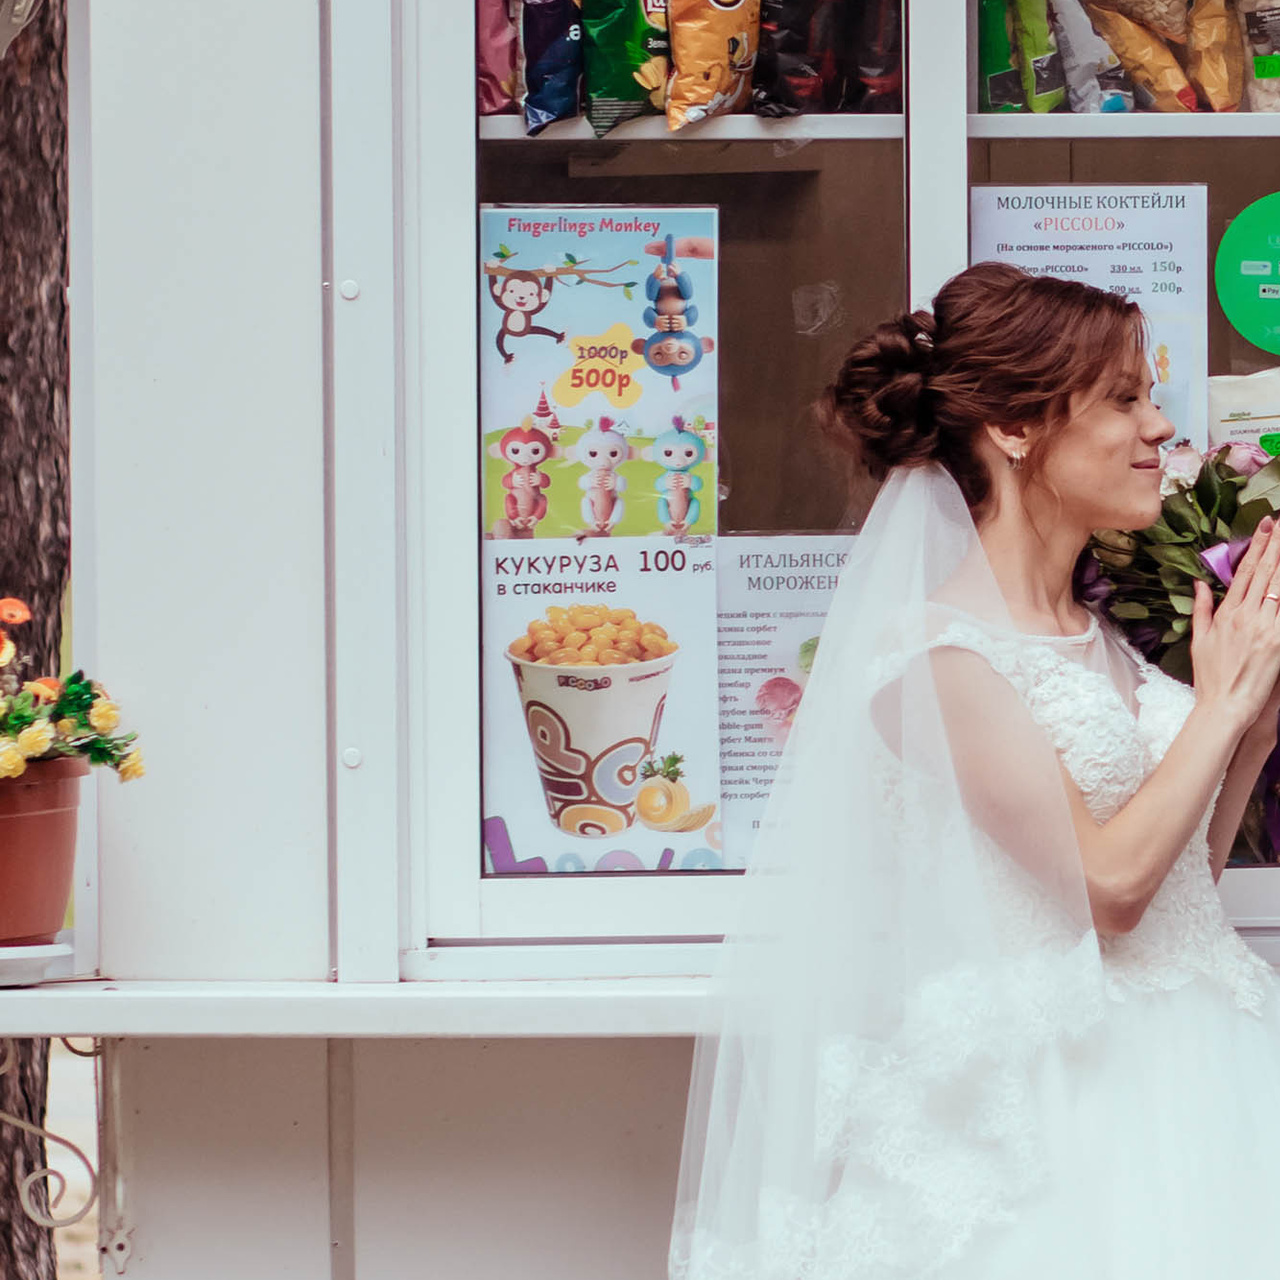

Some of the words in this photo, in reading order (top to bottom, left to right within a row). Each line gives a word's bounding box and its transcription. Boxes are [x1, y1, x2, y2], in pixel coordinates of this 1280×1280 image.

[997, 195, 1092, 210] МОЛОЧНЫЕ
[1096, 192, 1186, 209] КОКТЕЙЛИ
[507, 216, 595, 238] Fingerlings
[599, 216, 661, 238] Monkey
[1033, 217, 1125, 232] «PICCOLO»
[1015, 244, 1051, 252] основе
[1052, 243, 1114, 253] мороженого
[1110, 264, 1128, 274] 330
[494, 554, 620, 576] КУКУРУЗА
[638, 549, 687, 573] 100
[692, 560, 715, 573] руб.
[738, 553, 849, 569] ИТАЛЬЯНСК
[496, 583, 508, 596] в
[512, 579, 617, 595] стаканчике
[747, 575, 839, 591] МОРОЖЕН
[746, 625, 778, 634] сорбет
